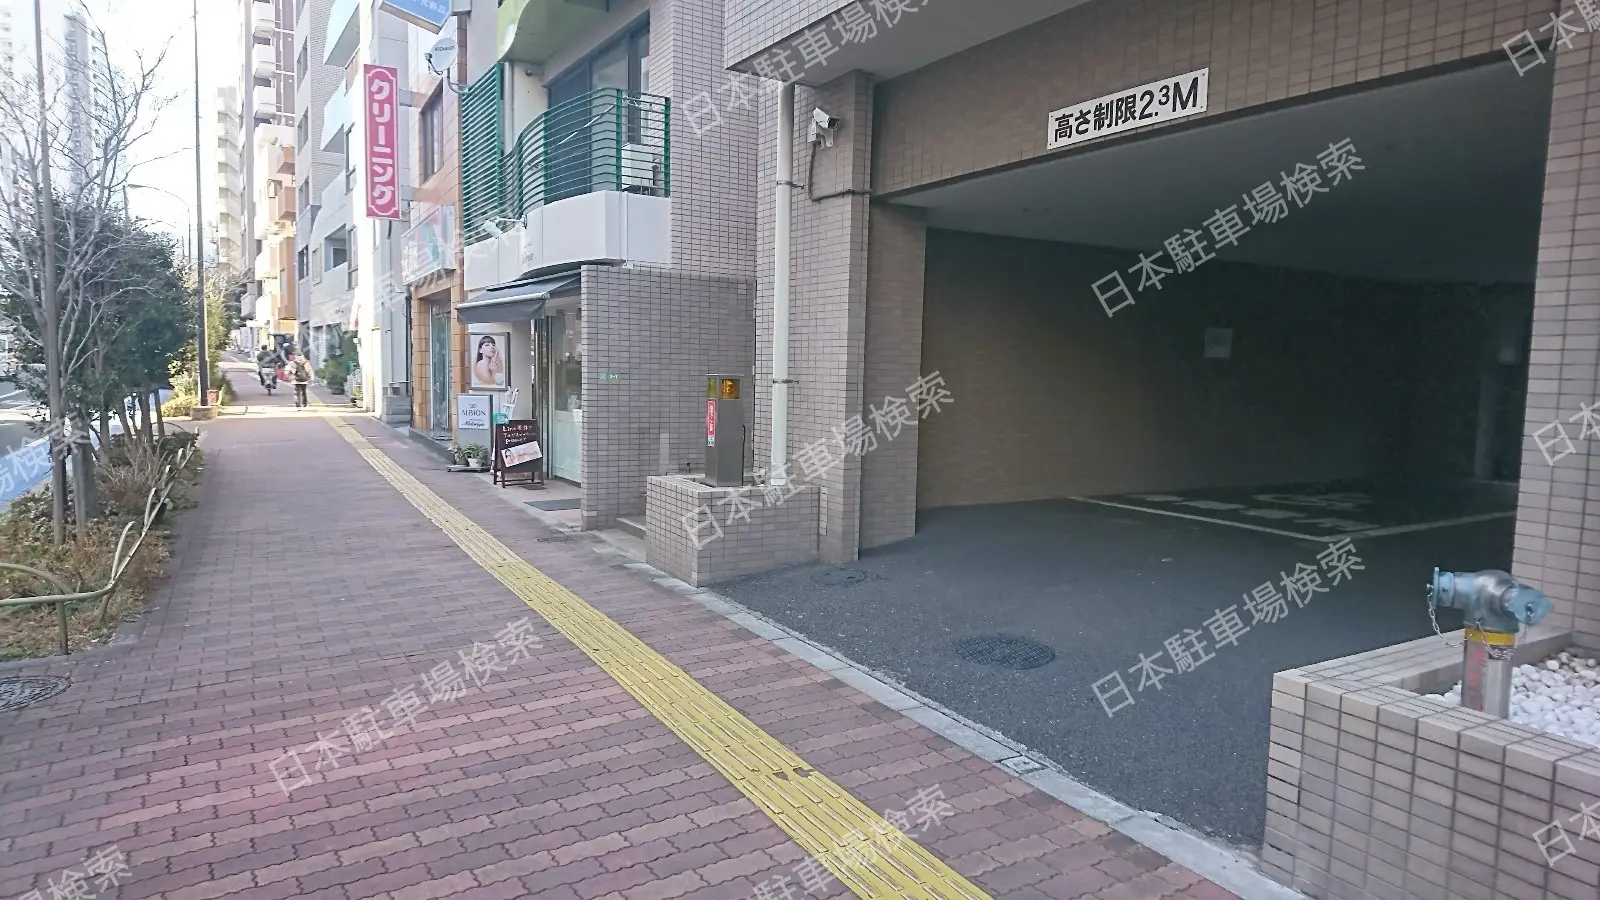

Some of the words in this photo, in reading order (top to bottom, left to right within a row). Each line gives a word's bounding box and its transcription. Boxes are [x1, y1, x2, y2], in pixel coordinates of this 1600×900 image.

[371, 79, 394, 205] クリーニング
[462, 409, 486, 417] ALBION
